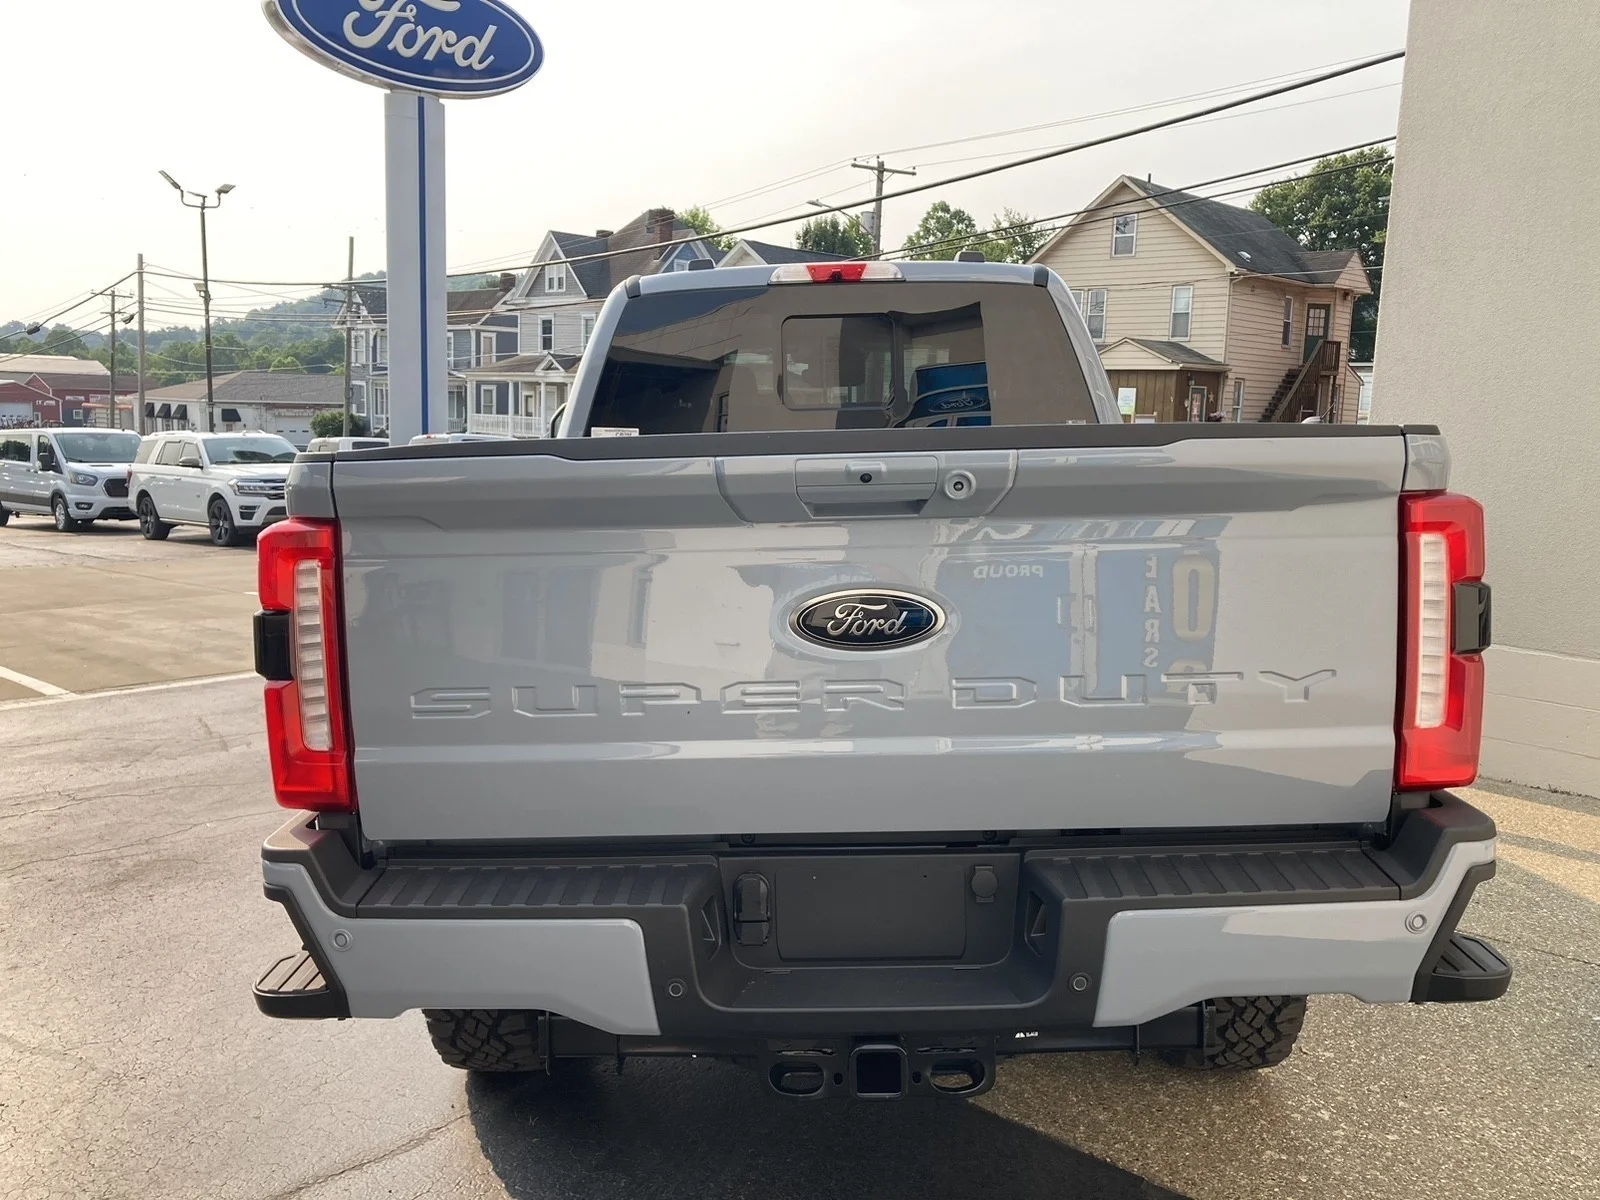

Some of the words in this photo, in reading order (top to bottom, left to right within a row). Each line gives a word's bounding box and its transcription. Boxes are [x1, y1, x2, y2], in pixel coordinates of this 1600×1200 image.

[343, 0, 497, 70] Ford
[826, 603, 908, 636] Ford
[410, 678, 905, 719] SUPER
[952, 668, 1337, 710] DUTY
